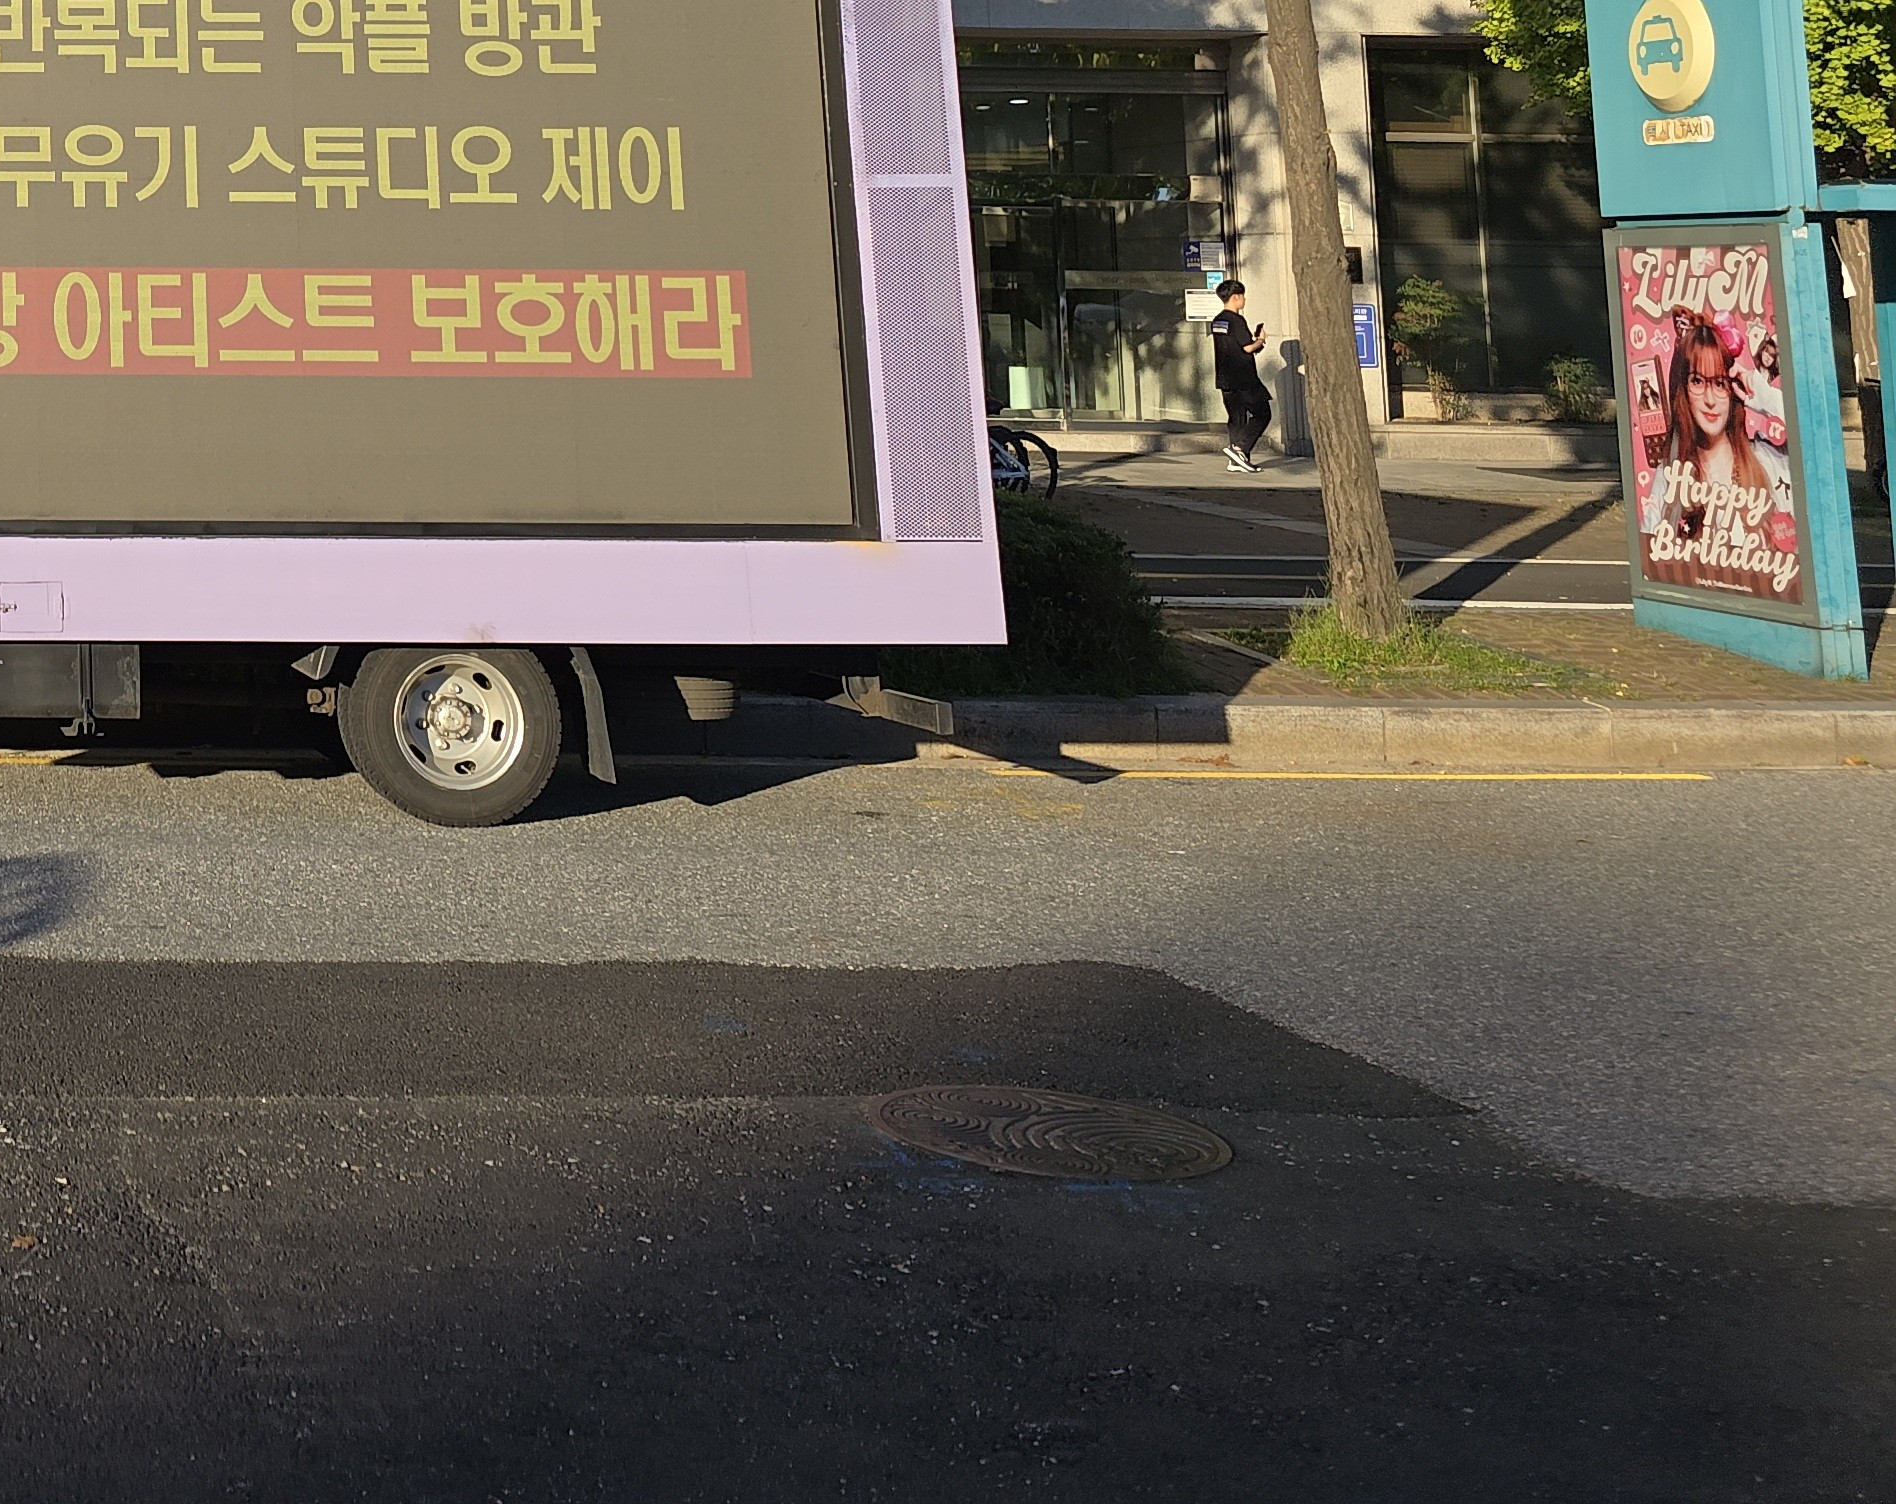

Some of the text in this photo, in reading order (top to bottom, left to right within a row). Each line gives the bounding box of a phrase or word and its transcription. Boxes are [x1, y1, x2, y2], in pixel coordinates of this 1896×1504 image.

[227, 124, 518, 209] 스튜디오
[542, 124, 685, 211] 제이
[52, 269, 379, 369] 아티스트
[410, 271, 742, 371] 보호해라
[1664, 459, 1773, 528] Happy
[1649, 519, 1800, 592] Birthday
